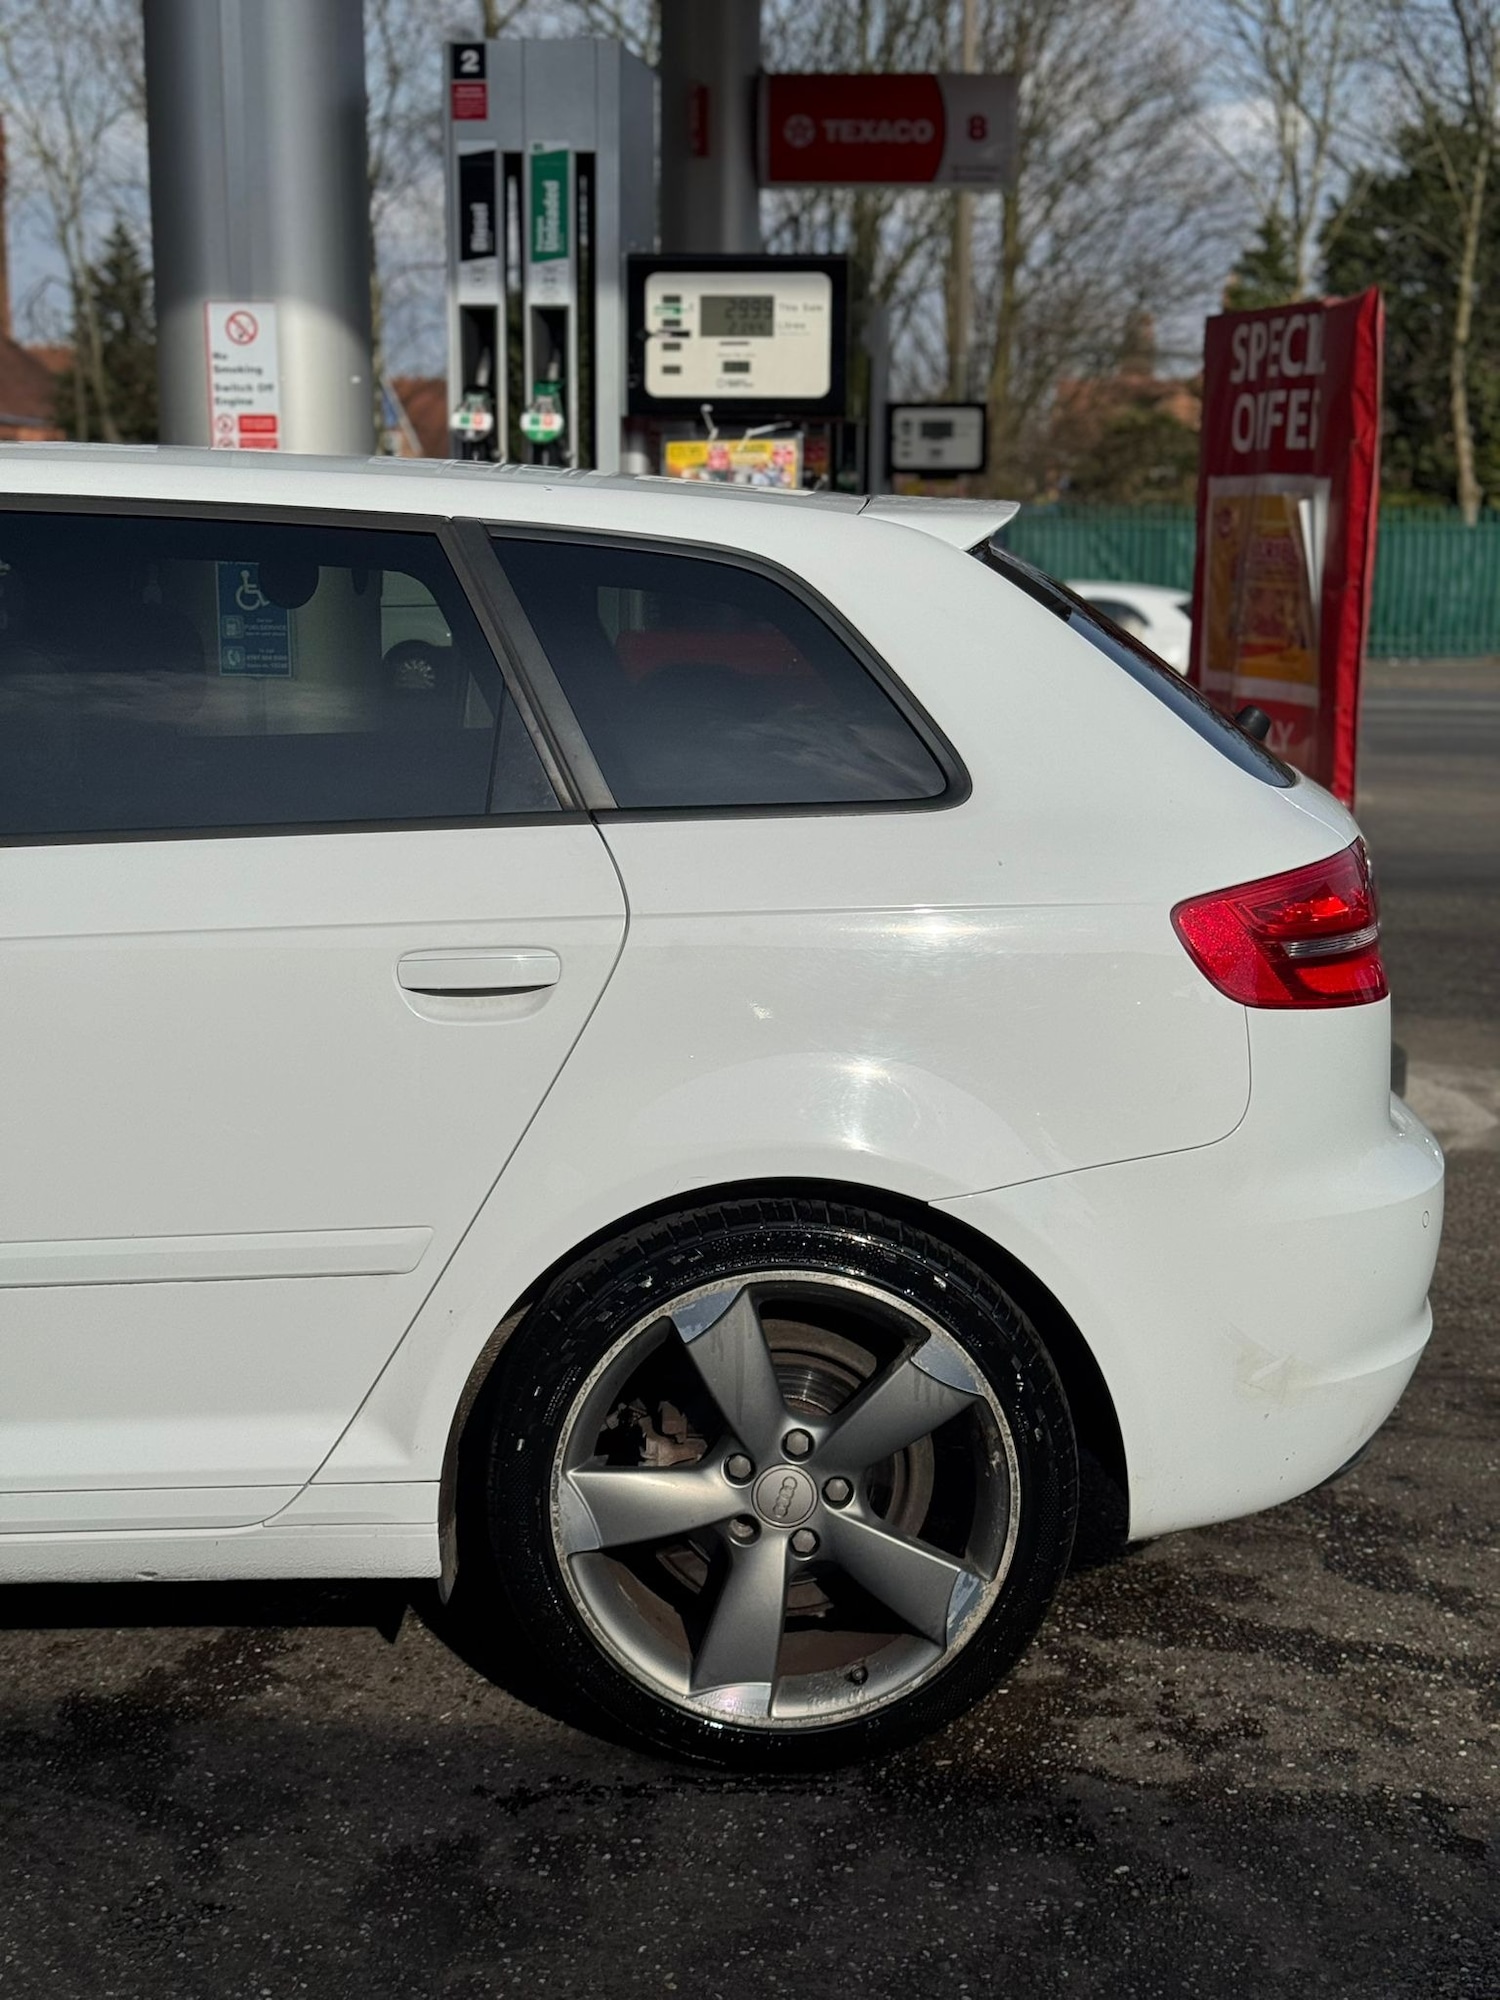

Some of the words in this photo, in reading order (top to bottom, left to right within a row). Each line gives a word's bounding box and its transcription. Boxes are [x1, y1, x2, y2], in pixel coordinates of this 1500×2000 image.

[461, 49, 479, 73] 2
[821, 118, 935, 144] TEXACO
[214, 364, 263, 376] Smoking
[214, 382, 253, 393] Switch
[215, 396, 253, 408] Engine
